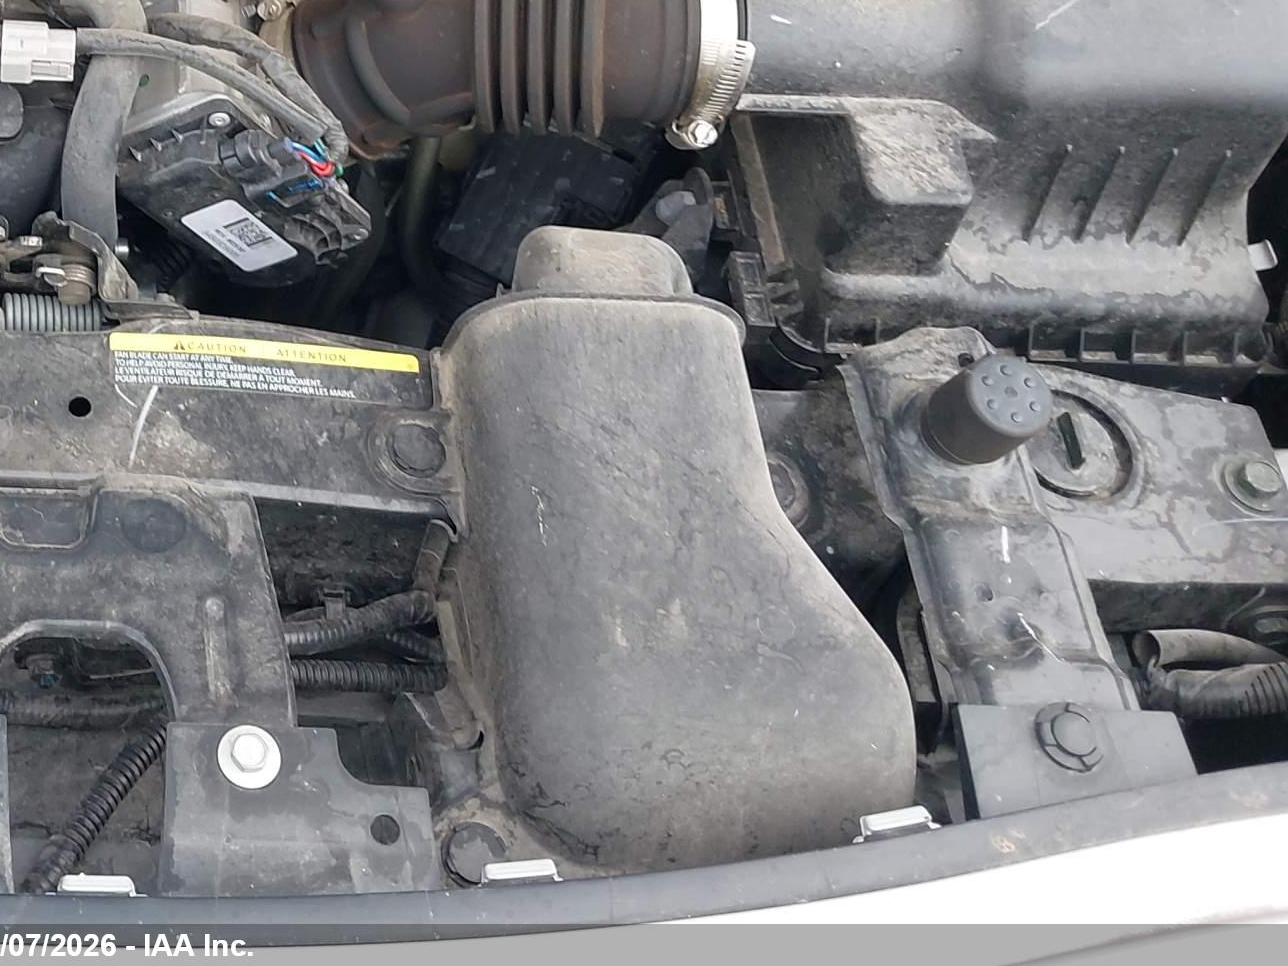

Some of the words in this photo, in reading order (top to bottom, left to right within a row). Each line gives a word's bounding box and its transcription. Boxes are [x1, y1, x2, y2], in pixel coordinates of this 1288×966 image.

[153, 352, 168, 362] CAN
[186, 341, 246, 354] CAUTION
[276, 348, 347, 363] ATTENTION
[127, 359, 144, 368] HELP
[145, 360, 166, 370] AVOID
[167, 361, 202, 371] PERSONAL
[230, 365, 246, 374] KEEP
[248, 366, 271, 375] HANDS
[115, 374, 137, 384] POUR
[164, 378, 190, 388] TOUTE
[241, 383, 256, 392] PAS
[269, 385, 314, 396] APPROCHER
[316, 388, 328, 397] LES
[176, 370, 203, 380] RISQUE
[266, 375, 285, 385] TOUT
